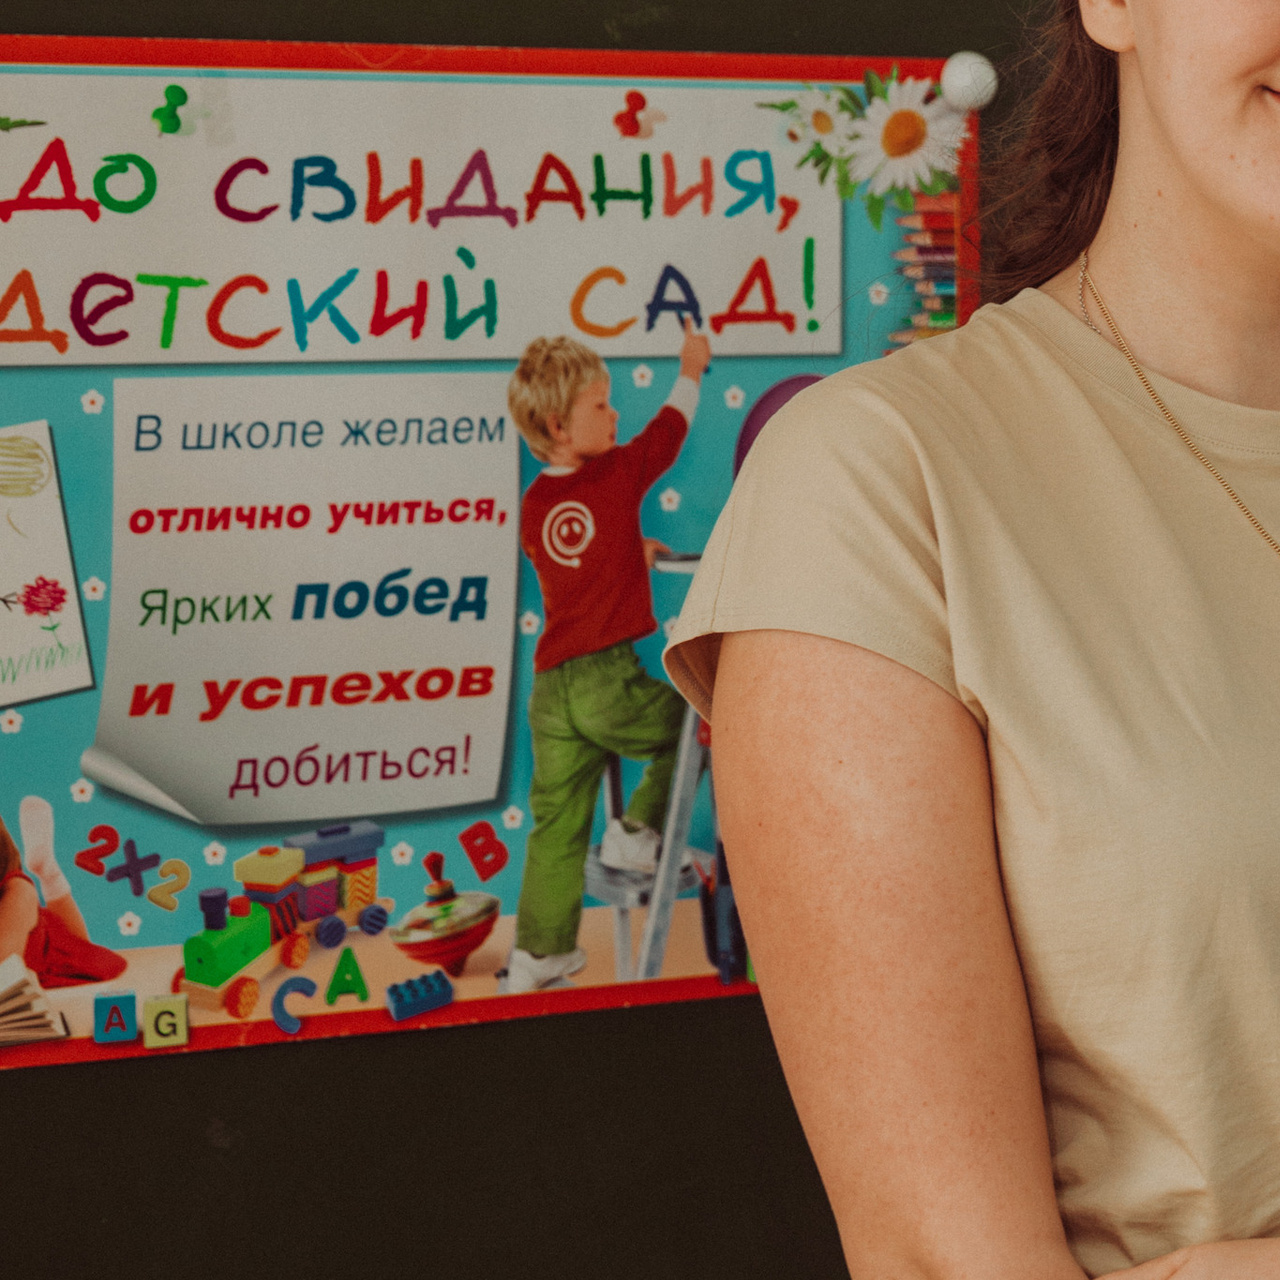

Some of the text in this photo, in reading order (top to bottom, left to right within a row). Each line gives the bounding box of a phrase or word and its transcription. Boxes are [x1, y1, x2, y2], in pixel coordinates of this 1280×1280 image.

[134, 414, 506, 452] В школе желаем
[128, 497, 508, 535] отлично учиться,
[138, 567, 491, 637] Ярких побед
[128, 665, 496, 723] и успехов
[228, 734, 473, 800] добиться!
[152, 1009, 179, 1039] G
